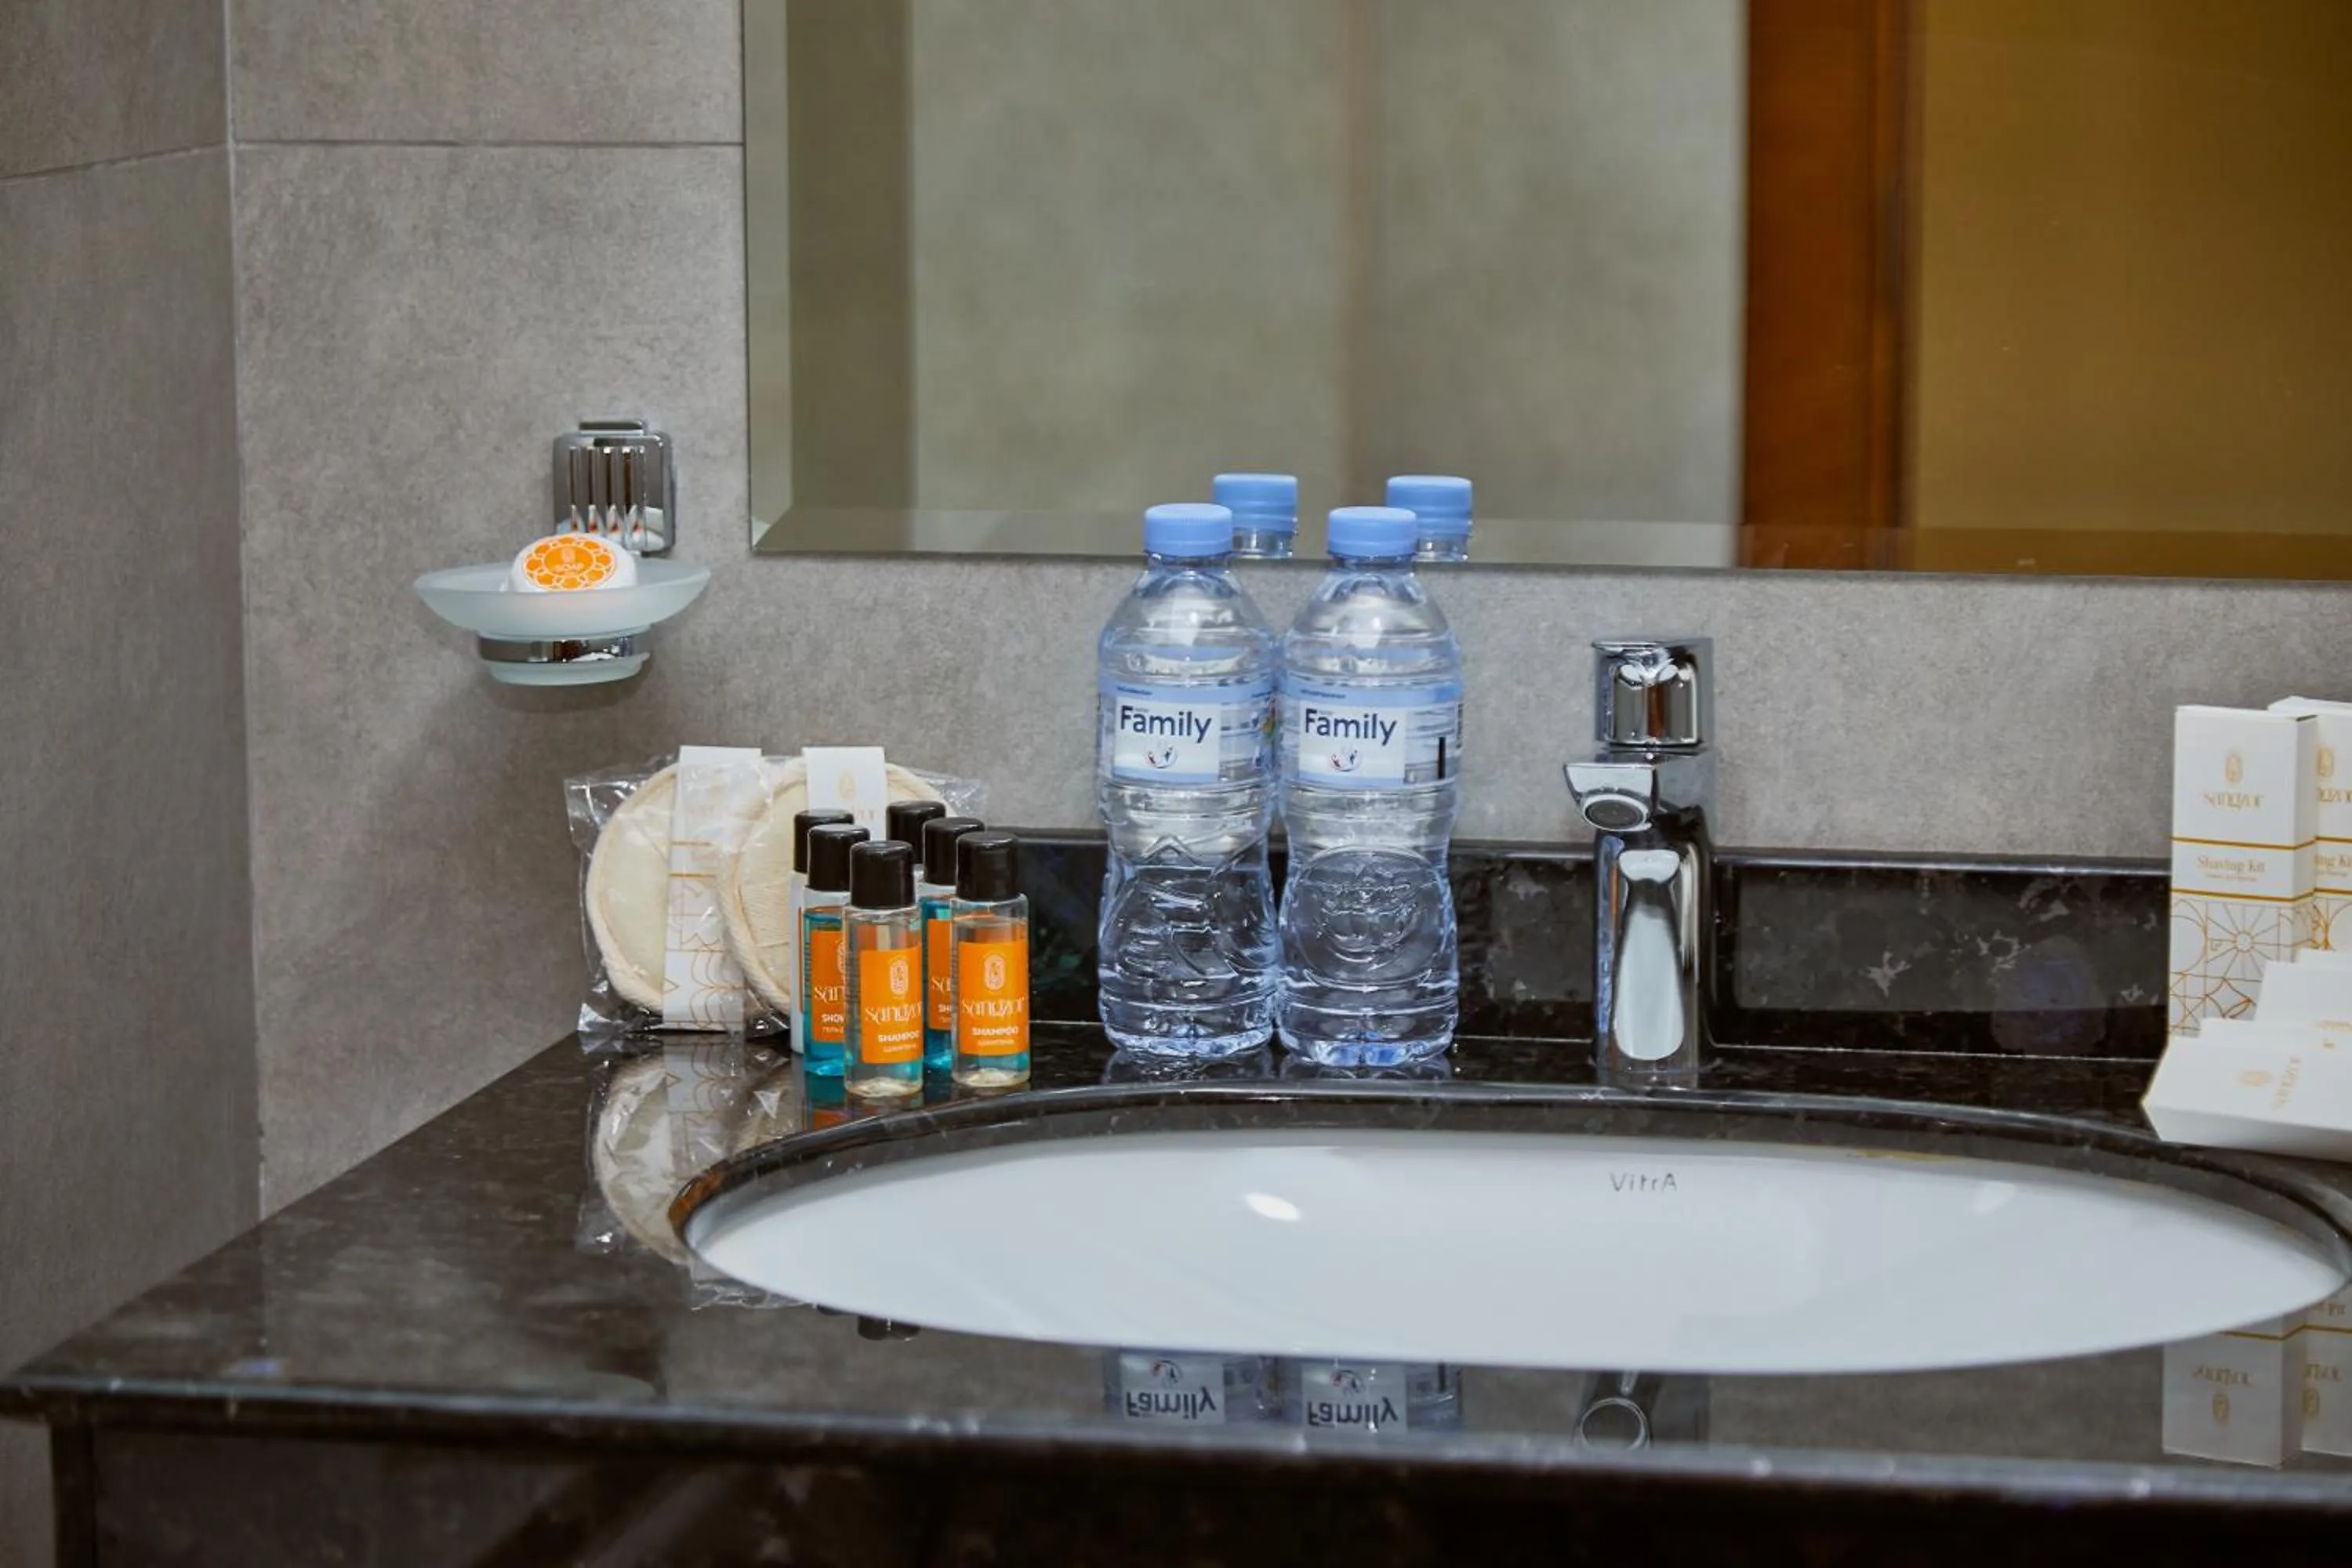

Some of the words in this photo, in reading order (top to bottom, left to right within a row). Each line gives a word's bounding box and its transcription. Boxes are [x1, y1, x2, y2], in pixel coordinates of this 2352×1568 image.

[1120, 705, 1212, 744] Family
[1305, 708, 1397, 746] Family
[1610, 1172, 1677, 1192] VitrA
